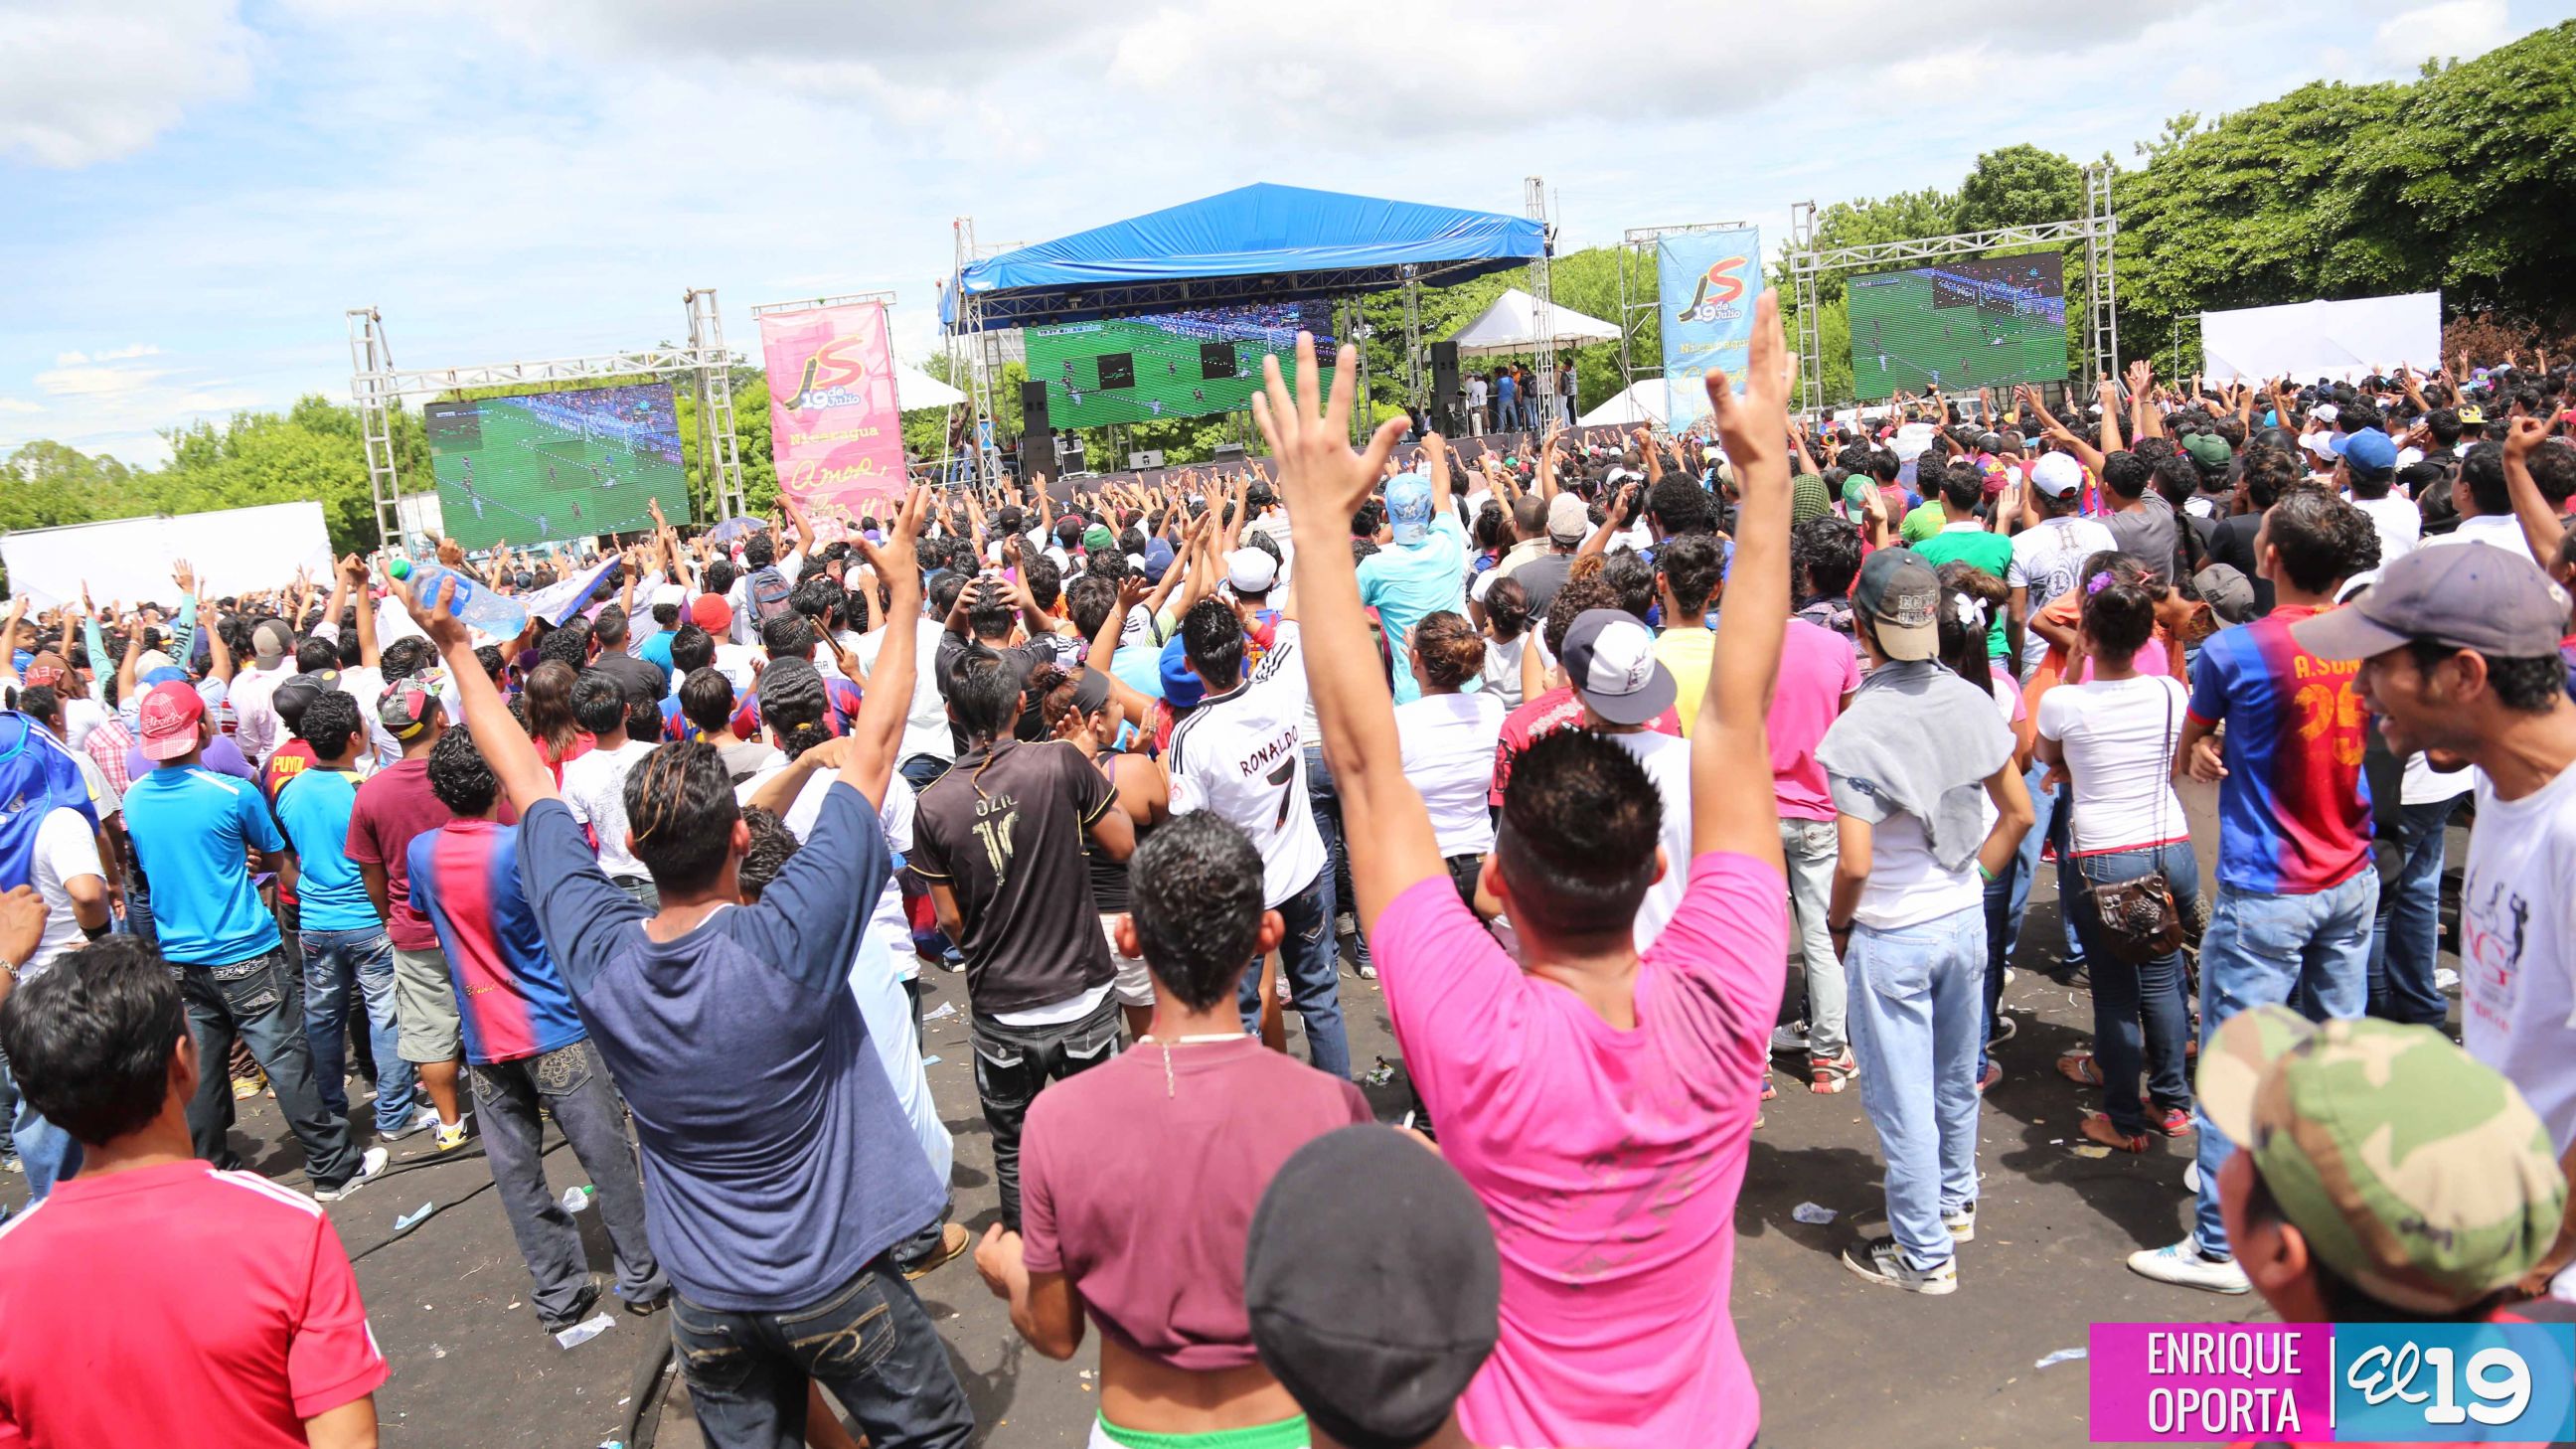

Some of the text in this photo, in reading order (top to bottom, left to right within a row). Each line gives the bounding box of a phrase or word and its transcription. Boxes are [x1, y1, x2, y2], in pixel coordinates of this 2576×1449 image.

[1693, 301, 1741, 322] 19 de Julio
[801, 387, 861, 409] 19 de Julio
[790, 426, 879, 445] Nicaragua
[2294, 681, 2369, 765] 25
[1240, 725, 1298, 777] RONALDO
[1266, 755, 1295, 835] 7
